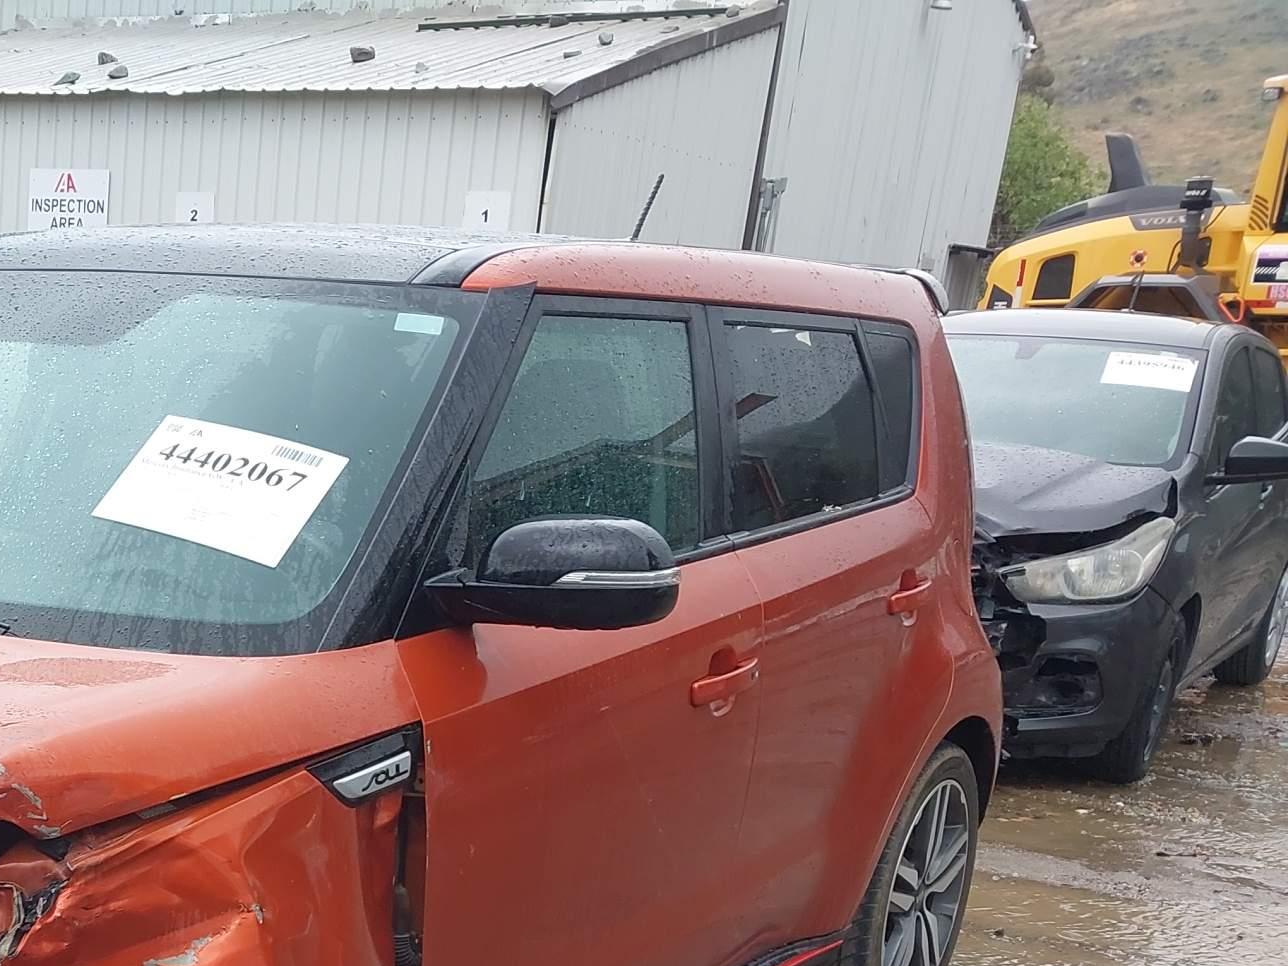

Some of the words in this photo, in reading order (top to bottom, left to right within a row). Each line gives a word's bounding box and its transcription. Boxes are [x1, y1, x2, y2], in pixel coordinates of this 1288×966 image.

[31, 198, 106, 214] INSPECTION
[190, 208, 198, 222] 2
[481, 208, 489, 223] 1
[159, 443, 309, 492] 44402067
